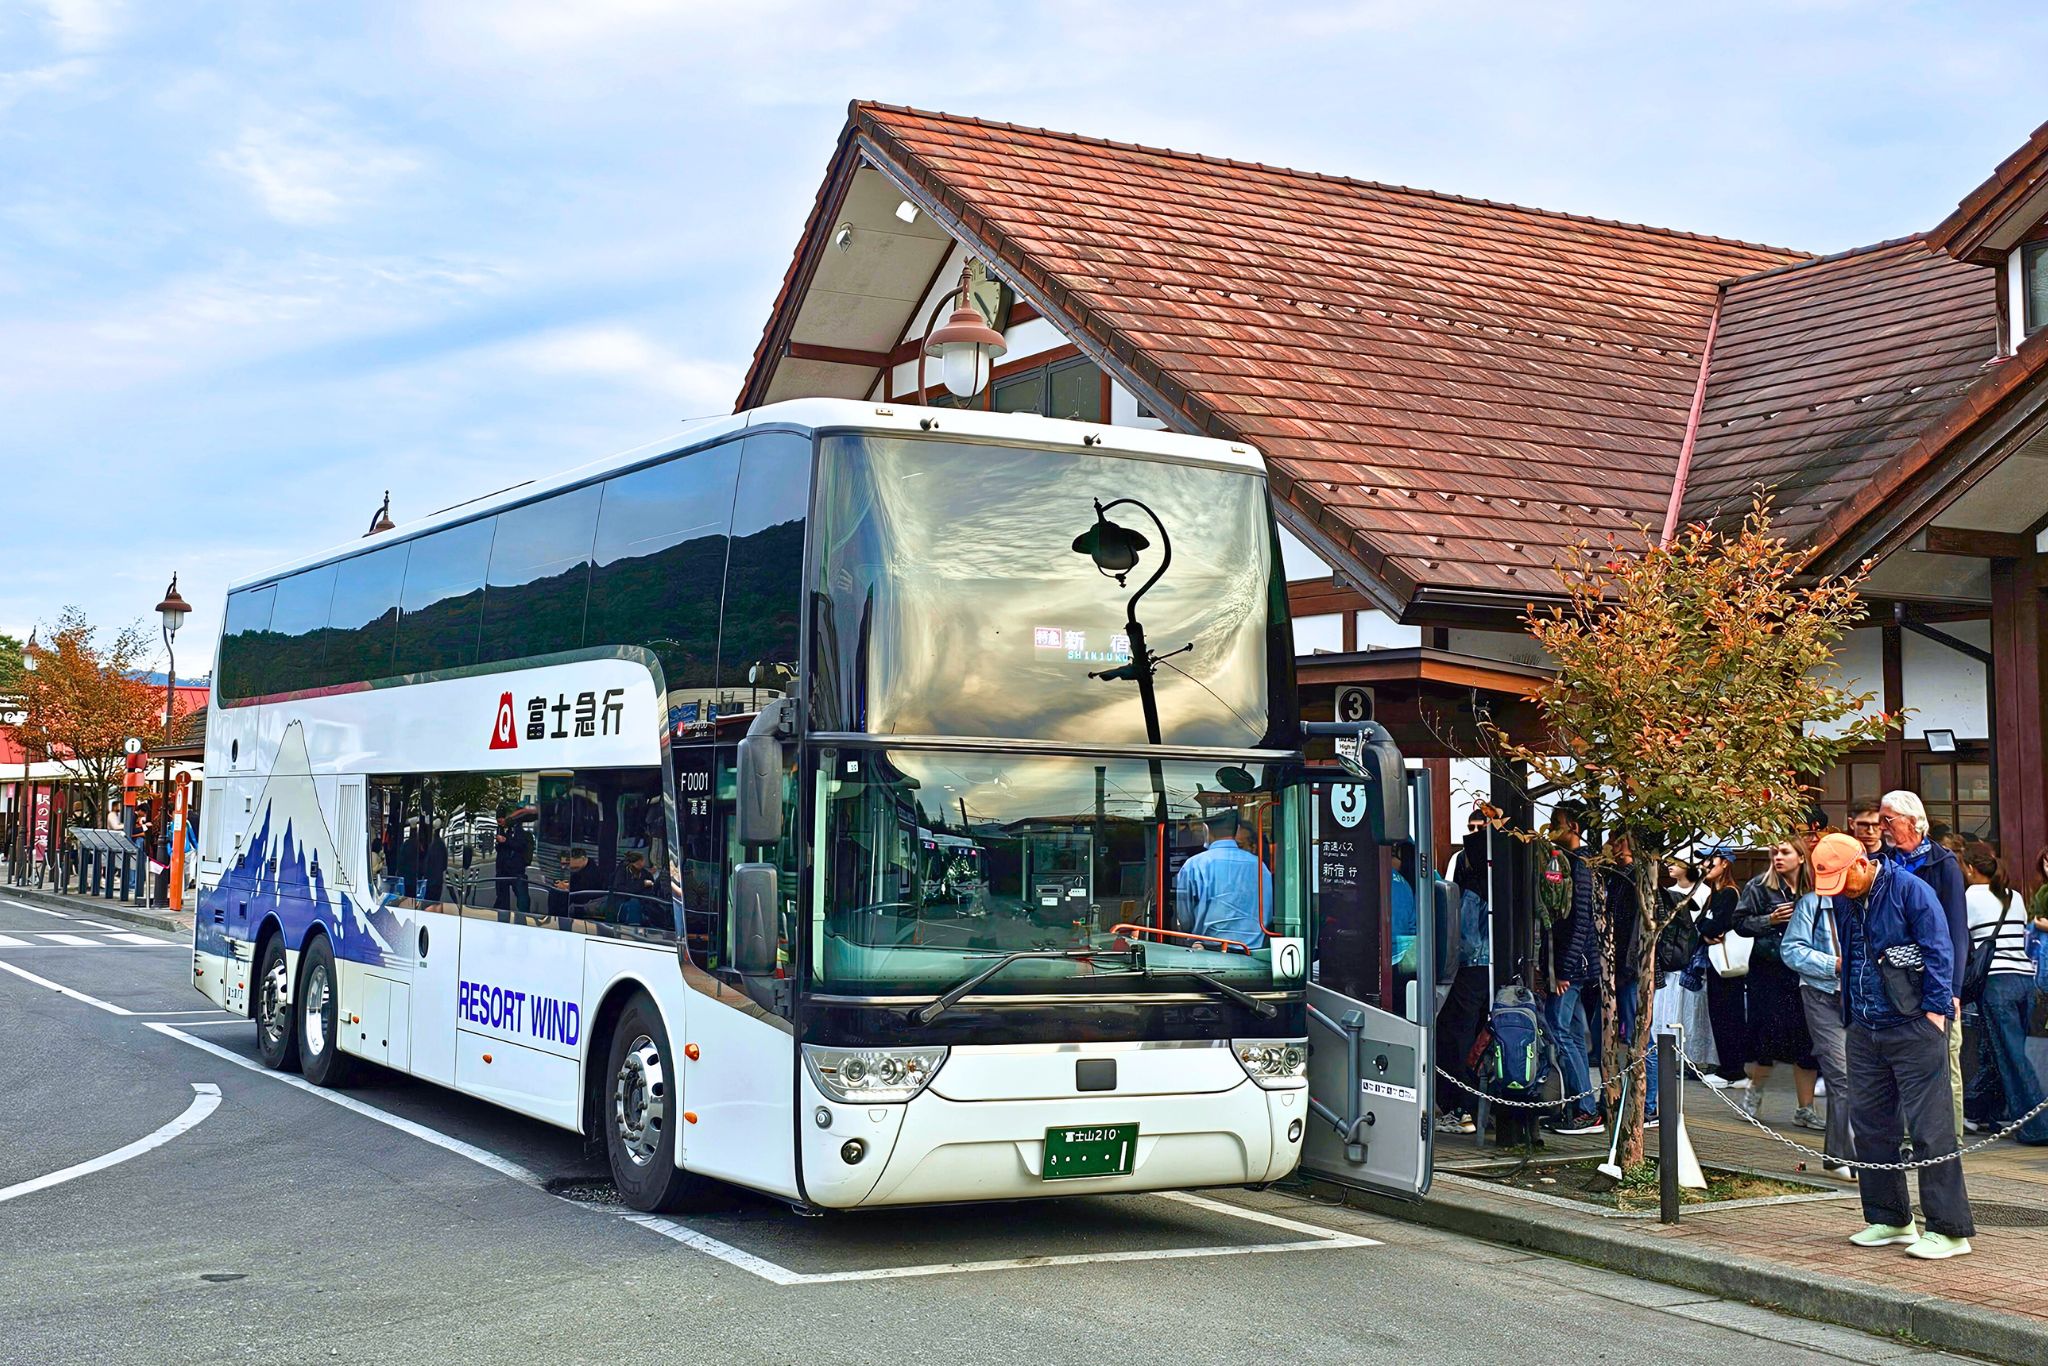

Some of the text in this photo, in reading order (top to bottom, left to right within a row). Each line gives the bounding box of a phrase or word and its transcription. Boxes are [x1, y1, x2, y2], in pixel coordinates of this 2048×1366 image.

[526, 688, 625, 740] 富士急行
[1348, 692, 1363, 720] 3
[681, 773, 709, 791] F0001
[1340, 784, 1356, 813] 3
[1323, 863, 1345, 877] 新宿
[459, 980, 580, 1046] RESORT WIND
